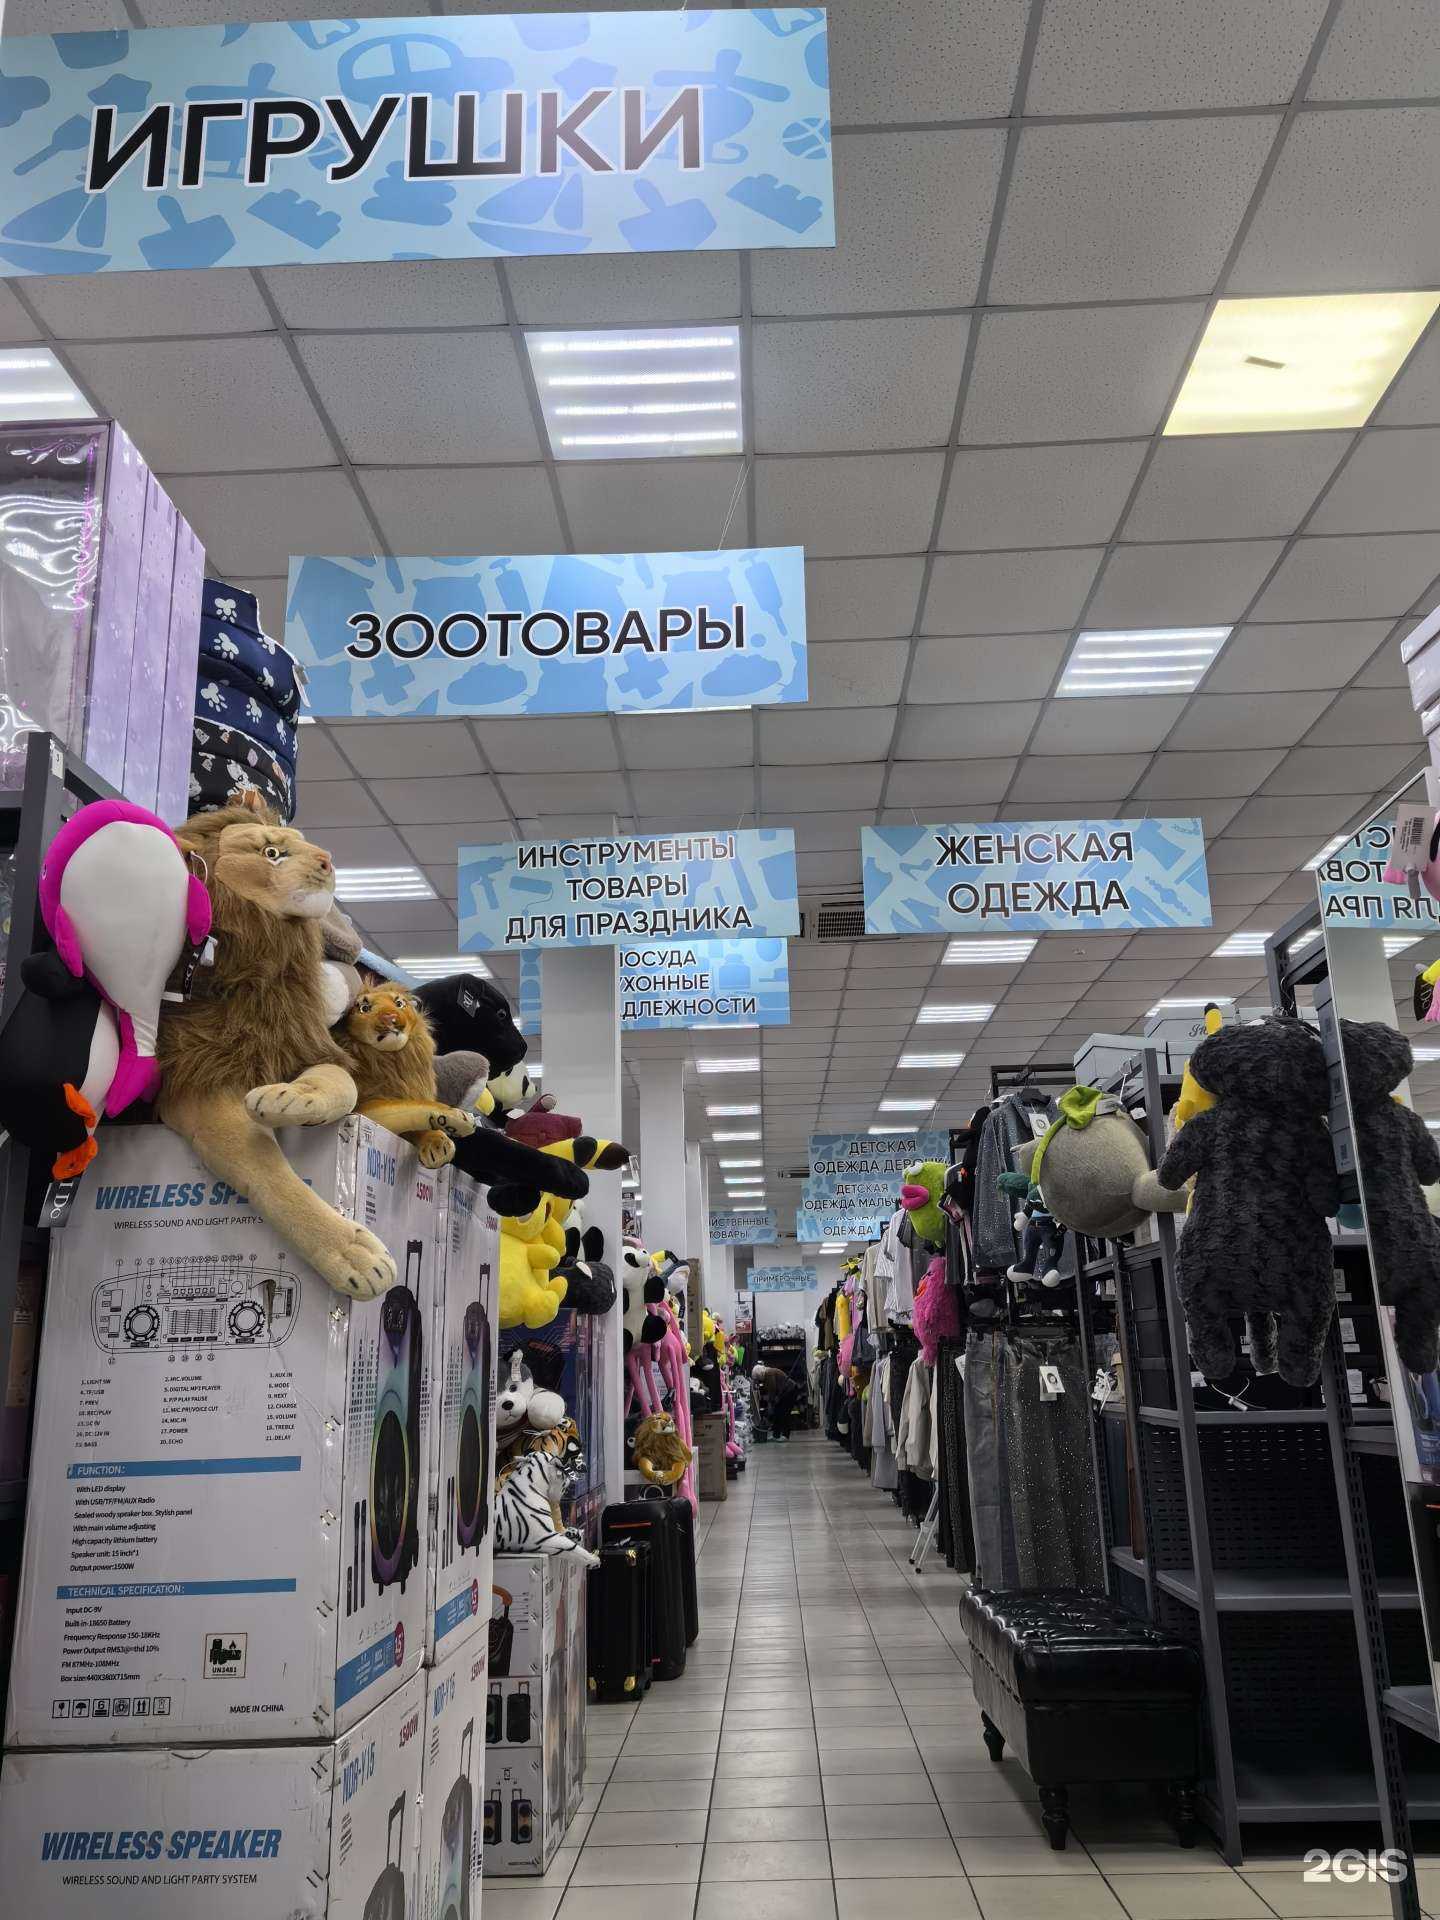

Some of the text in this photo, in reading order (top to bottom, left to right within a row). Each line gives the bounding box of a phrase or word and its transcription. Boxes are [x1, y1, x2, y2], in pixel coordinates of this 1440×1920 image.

[87, 87, 703, 194] ИГРУШКИ
[346, 604, 745, 659] ЗООТОВАРЫ
[517, 835, 735, 869] ИНСТРУМЕНТЫ
[935, 831, 1134, 866] ЖЕНСКАЯ
[567, 874, 688, 902] ТОВАРЫ
[948, 880, 1131, 919] ОДЕЖДА
[505, 905, 752, 944] ДЛЯ ПРАЗДНИКА
[619, 973, 710, 993] ХОННЫЕ
[621, 997, 757, 1019] ДЛЕЖНОСТИ
[849, 1140, 916, 1155] ДЕТСКАЯ
[814, 1160, 880, 1174] ОДЕЖДА
[96, 1181, 206, 1210] WIRELESS
[836, 1184, 889, 1195] ДЕТСКАЯ
[805, 1199, 855, 1210] ОДЕЖДА
[113, 1218, 152, 1230] WIRELESS
[154, 1218, 184, 1228] SOUND
[186, 1218, 204, 1227] AND
[205, 1217, 229, 1226] LIGHT
[231, 1216, 256, 1225] PARTY
[823, 1226, 873, 1236] ОДЕЖДА
[104, 1485, 125, 1493] display
[95, 1512, 116, 1520] woody
[116, 1511, 140, 1519] speaker
[155, 1509, 175, 1517] Stylish
[176, 1508, 192, 1517] panel
[128, 1523, 156, 1532] adjusting
[72, 1536, 158, 1546] High capacity lithium battery
[71, 1551, 96, 1560] Speaker
[70, 1564, 92, 1573] Output
[68, 1584, 185, 1597] TECHNICAL SPECIFICATION:
[66, 1607, 83, 1615] Input
[108, 1618, 131, 1627] Battery
[64, 1633, 96, 1642] Frequency
[97, 1632, 127, 1641] Response
[63, 1647, 83, 1655] Power
[83, 1646, 106, 1655] Output
[60, 1674, 73, 1682] Box
[230, 1704, 284, 1714] MADE IN CHINA
[41, 1829, 282, 1861] WIRELESS SPEAKER
[62, 1873, 258, 1887] WIRELESS SOUND AND LIGHT PARTY SYSTEM
